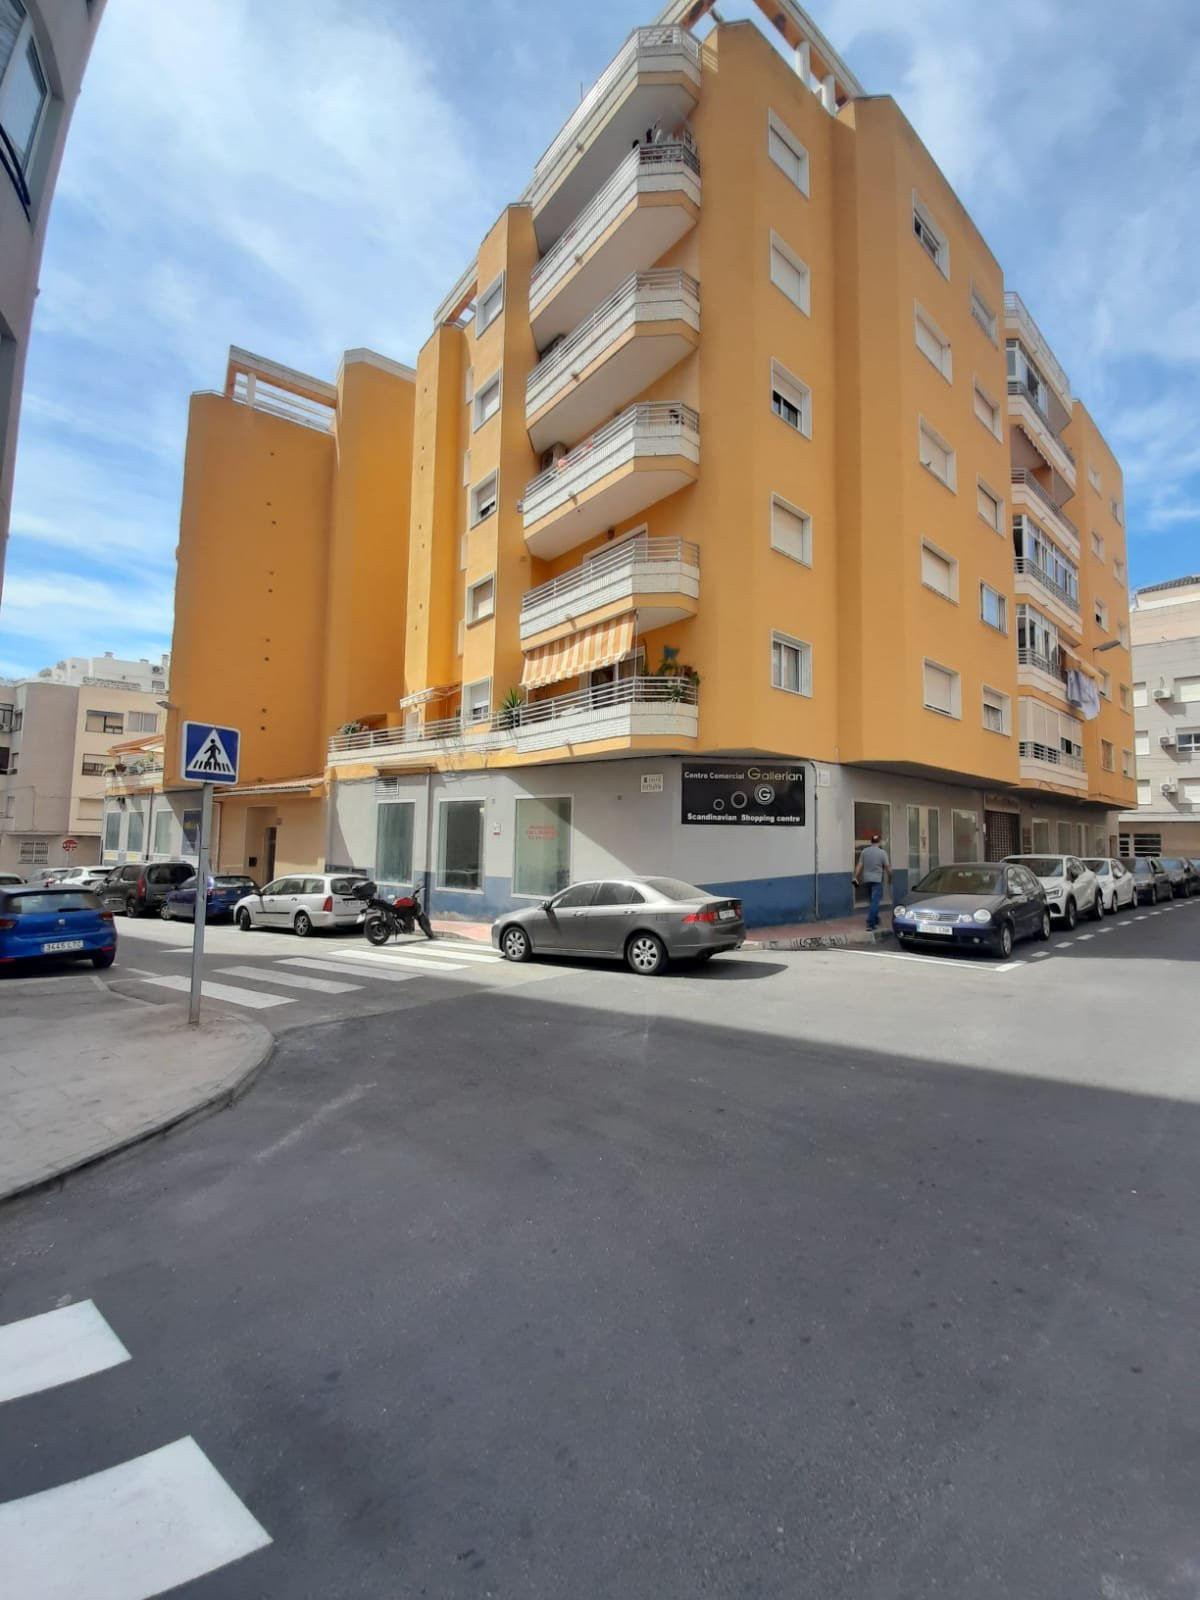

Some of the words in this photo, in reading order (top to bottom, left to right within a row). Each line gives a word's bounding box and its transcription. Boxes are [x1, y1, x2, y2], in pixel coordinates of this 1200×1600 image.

[709, 772, 745, 780] Comercial
[747, 767, 803, 782] Gallerian
[758, 787, 771, 801] G
[687, 813, 737, 821] Scandinavian
[741, 814, 775, 823] Shopping
